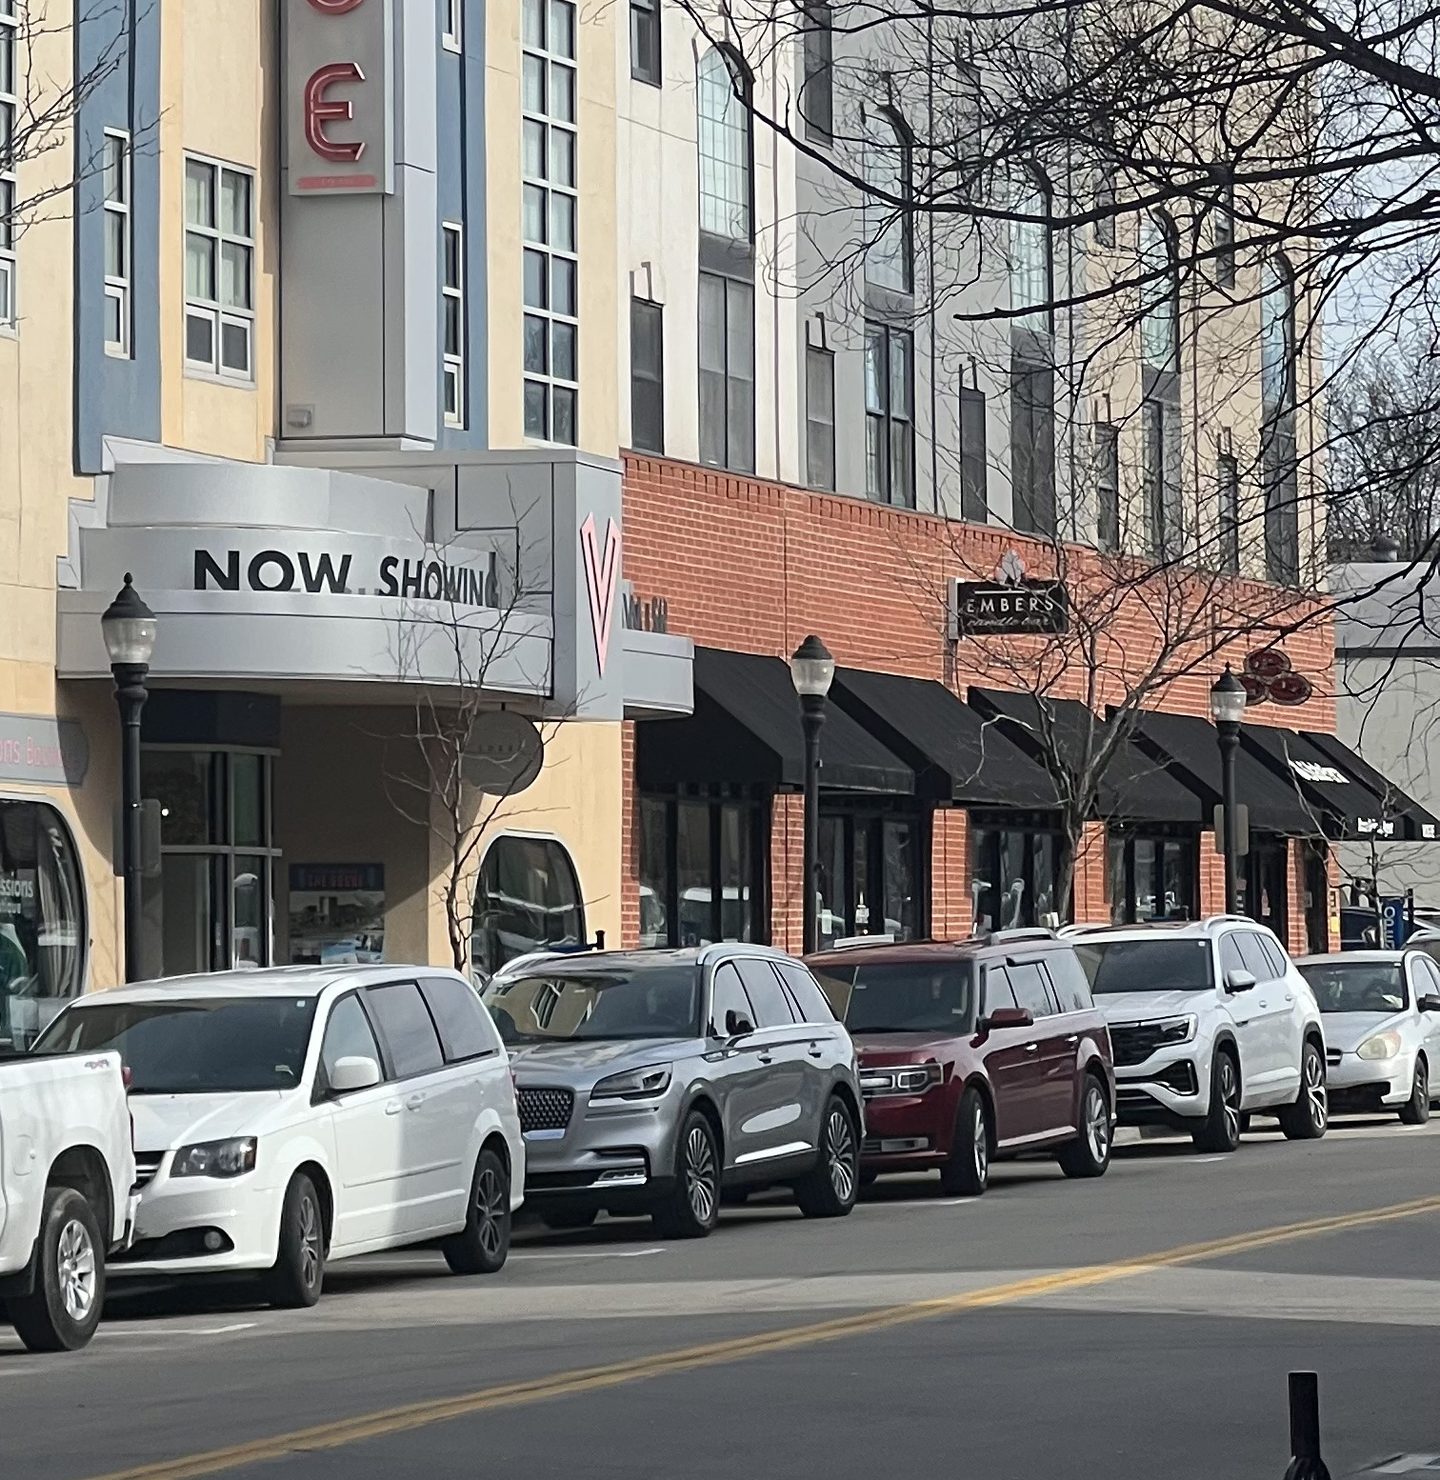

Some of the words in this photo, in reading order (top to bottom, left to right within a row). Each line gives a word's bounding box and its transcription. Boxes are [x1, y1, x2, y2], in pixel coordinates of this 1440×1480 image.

[194, 549, 352, 593] NOW
[379, 555, 499, 608] SHOWING
[966, 597, 1054, 613] EMBERS
